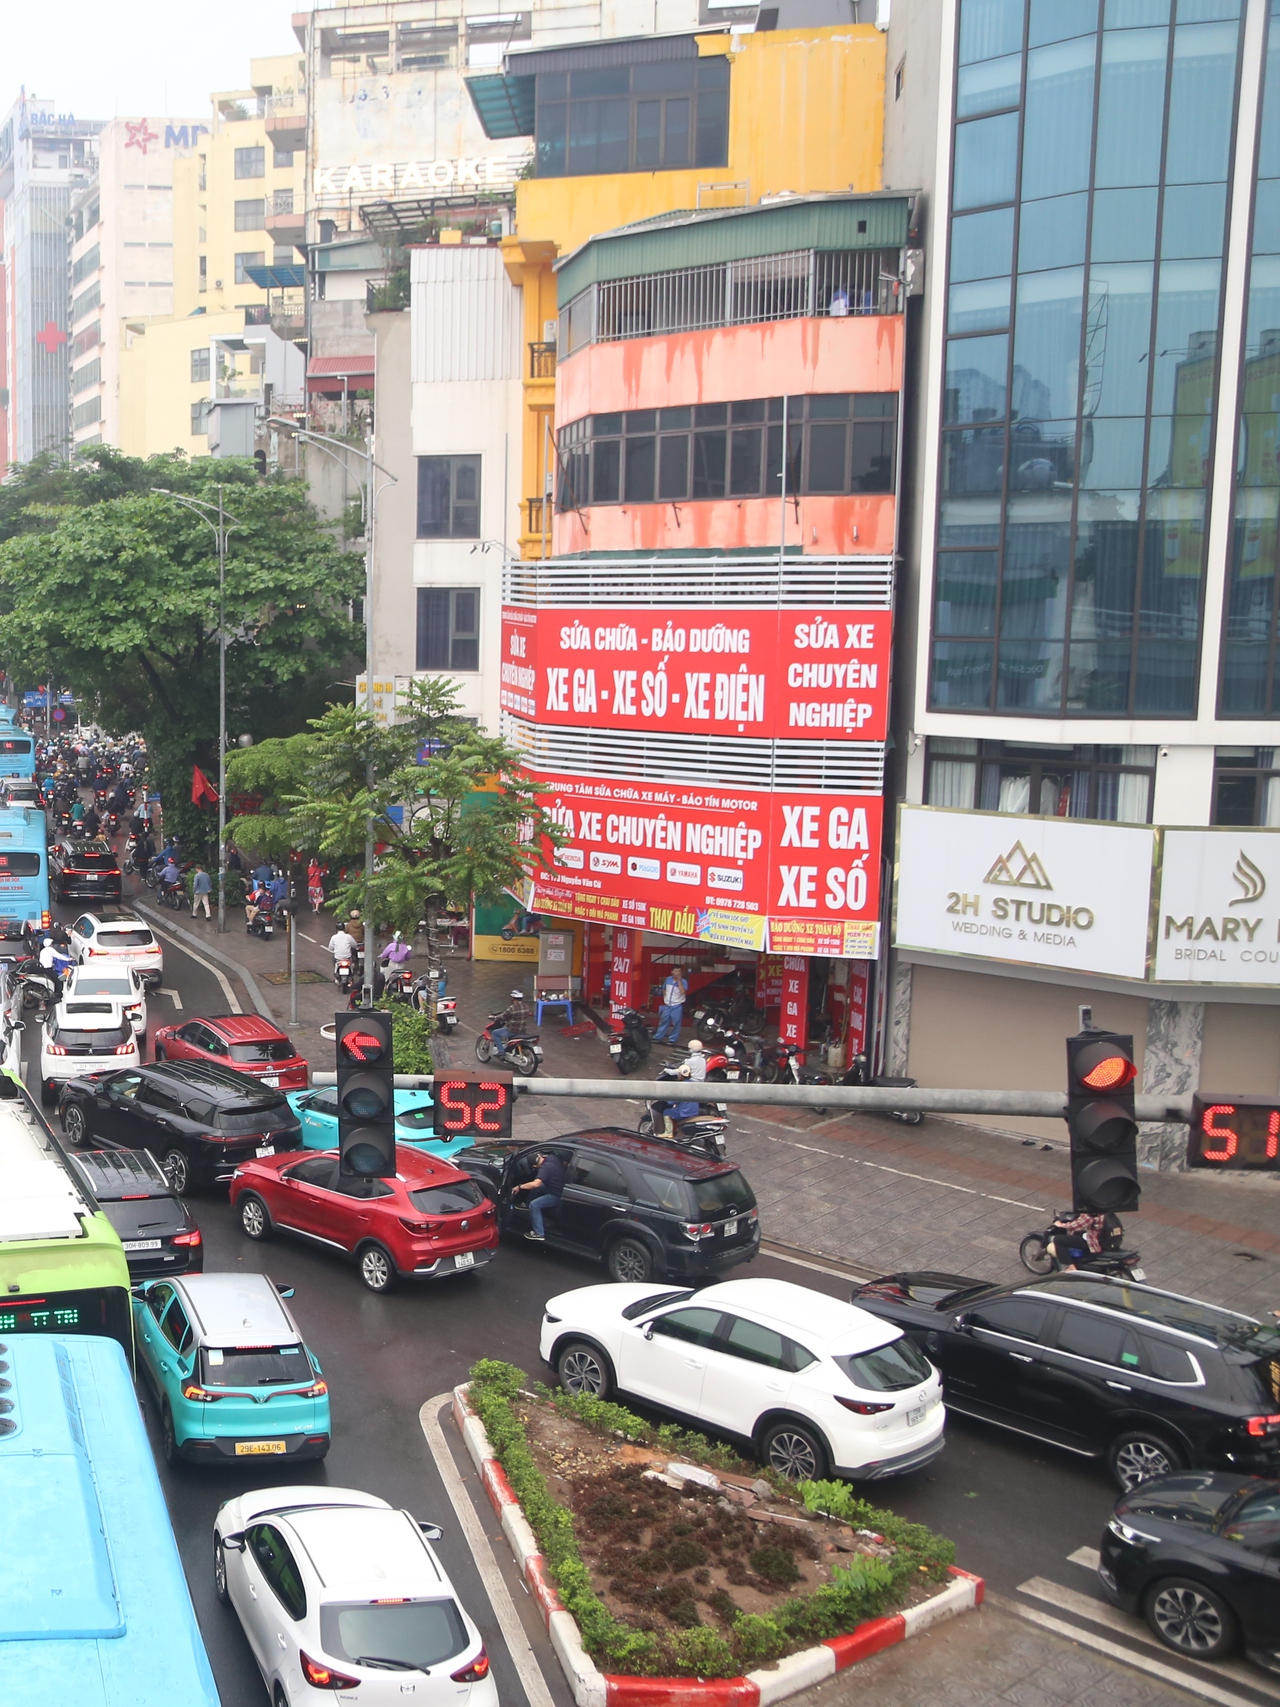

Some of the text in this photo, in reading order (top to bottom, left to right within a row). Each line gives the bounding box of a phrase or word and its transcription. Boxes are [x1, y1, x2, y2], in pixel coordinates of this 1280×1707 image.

[314, 156, 508, 195] KARAOKE
[560, 619, 591, 650] SỬA
[594, 623, 638, 651] CHỮA
[651, 620, 686, 652] BẢO
[689, 623, 750, 654] DƯỠNG
[794, 615, 875, 649] SỬA XE
[787, 658, 878, 689] CHUYÊN
[546, 667, 569, 711] XE
[573, 668, 597, 713] GA
[612, 670, 637, 716] XE
[641, 655, 669, 718] SỐ
[683, 672, 711, 720] XE
[714, 663, 765, 732] ĐIỆN
[789, 697, 873, 733] NGHIỆP
[545, 781, 758, 811] TRUNG TÂM SỬA CHỮA XE MÁY BẢO TÍN MOTOR
[578, 810, 603, 842] XE
[606, 813, 682, 852] CHUYÊN
[686, 821, 762, 866] NGHIỆP
[780, 805, 870, 850] XE GA
[601, 860, 619, 868] SYM
[678, 870, 698, 879] YAMAHA
[717, 874, 742, 884] SUZUKI
[777, 853, 870, 911] XE SỐ
[649, 906, 673, 931] THAY
[673, 905, 695, 935] DẦU
[946, 891, 1094, 931] 2H STUDIO
[951, 920, 1077, 948] WEDDING & MEDIA
[1164, 915, 1263, 942] MARY
[498, 946, 516, 954] 1800
[613, 956, 630, 974] 24/7
[1174, 948, 1227, 961] BRIDAL
[615, 980, 628, 1000] TẠI
[788, 979, 799, 994] XE
[787, 1001, 798, 1017] GA
[786, 1023, 798, 1039] XE
[440, 1081, 506, 1130] 52
[1202, 1105, 1280, 1161] 51
